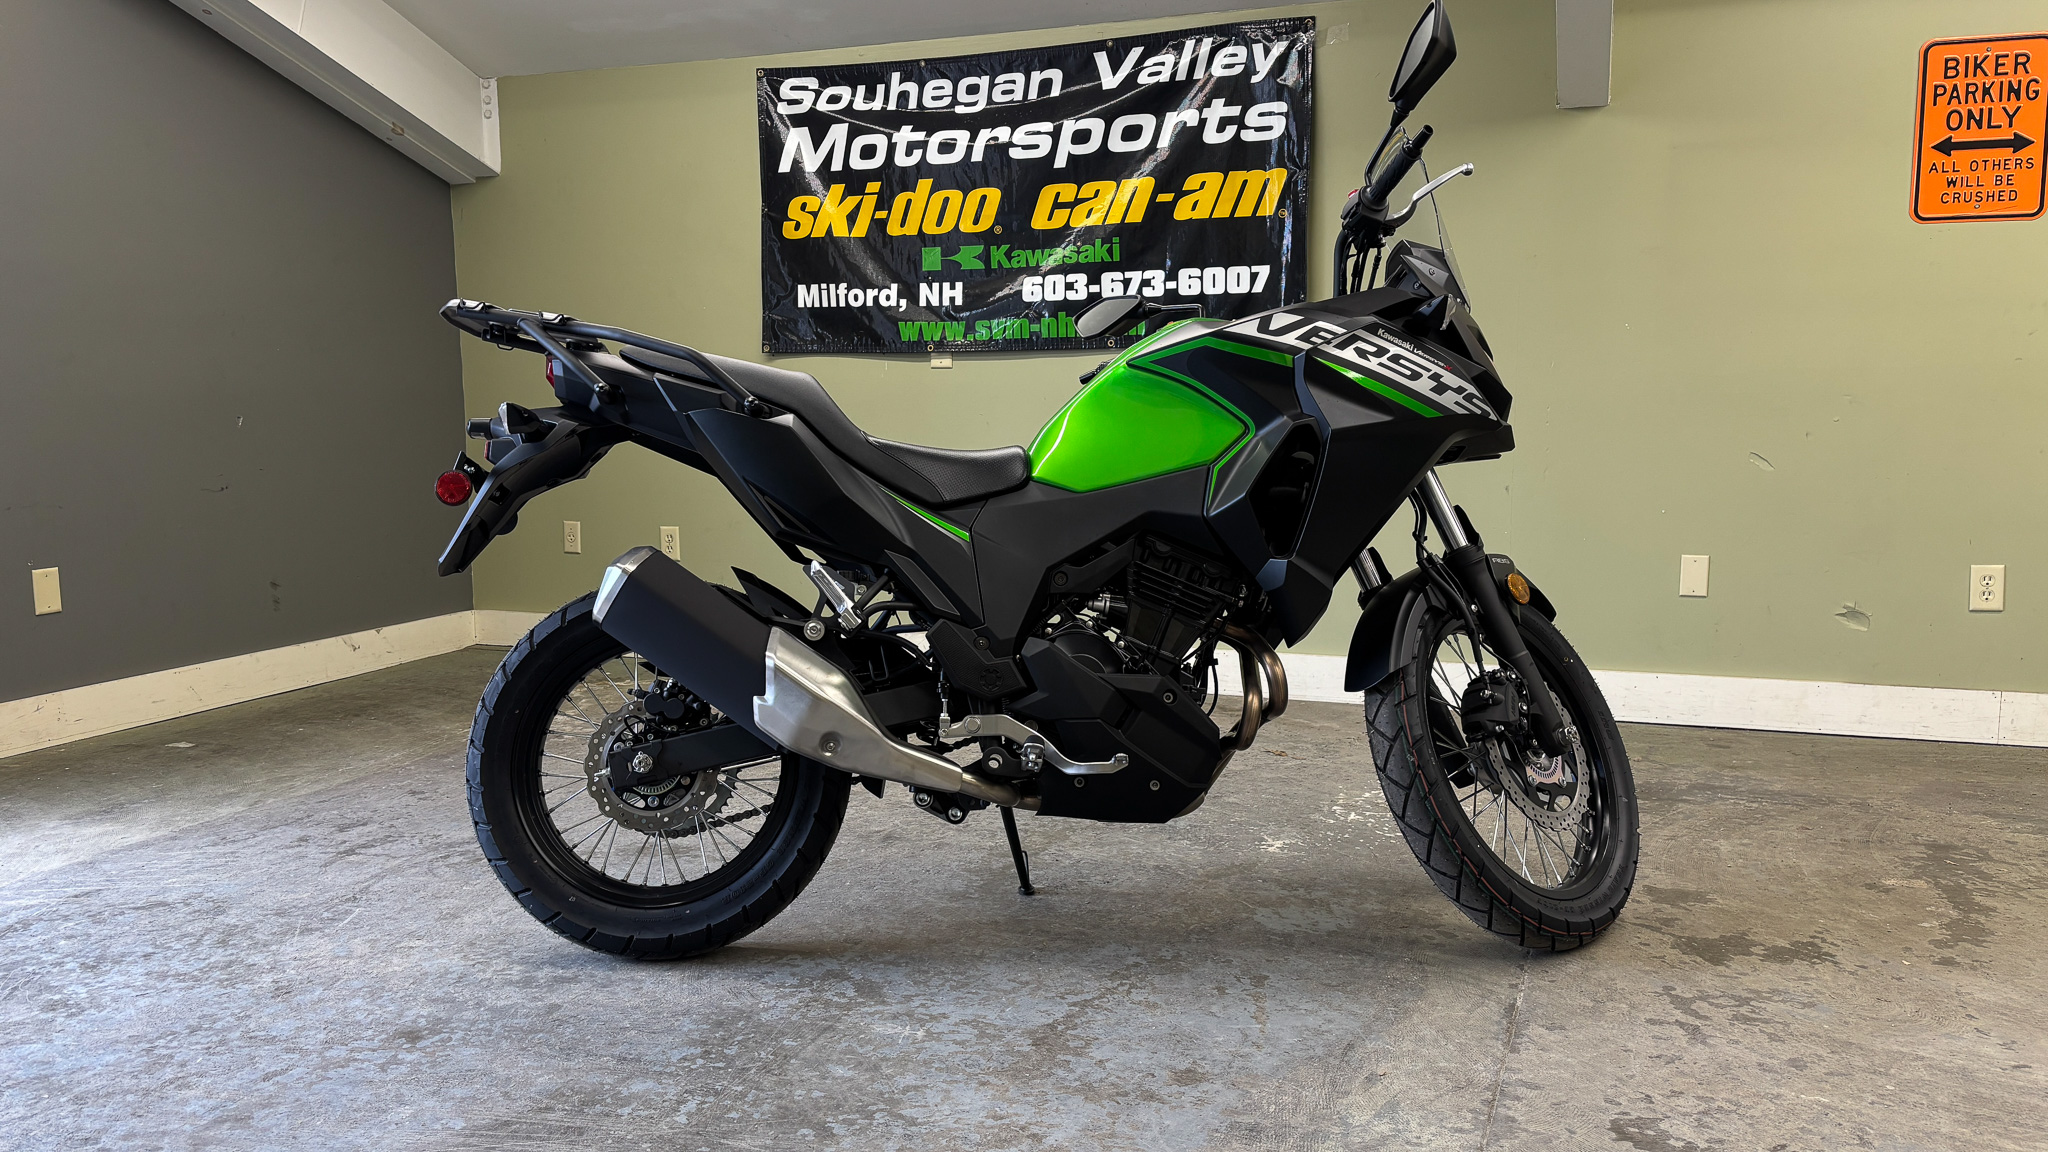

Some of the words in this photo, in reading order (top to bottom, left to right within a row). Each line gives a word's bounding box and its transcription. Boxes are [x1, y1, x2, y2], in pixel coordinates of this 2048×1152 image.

[777, 68, 1063, 114] Souhegan
[1093, 37, 1290, 90] Valley
[1943, 51, 2032, 80] BIKER
[1932, 77, 2041, 107] PARKING
[1946, 103, 2023, 131] ONLY
[778, 98, 1288, 173] Motorsports
[1928, 160, 1961, 175] ALL
[1969, 157, 2035, 172] OTHERS
[1940, 189, 2018, 204] CRUSHED
[1946, 175, 1985, 189] WILL
[1994, 174, 2015, 187] BE
[782, 178, 1001, 240] ski-doo
[1030, 167, 1288, 230] can-am
[991, 237, 1120, 269] Kawasaki
[796, 283, 908, 312] Milford,
[919, 281, 963, 307] NH
[1022, 265, 1270, 302] 603-673-6007
[898, 312, 1145, 341] www.svm-nh
[1377, 328, 1415, 352] Kawasaki
[1257, 312, 1492, 418] VERSYS
